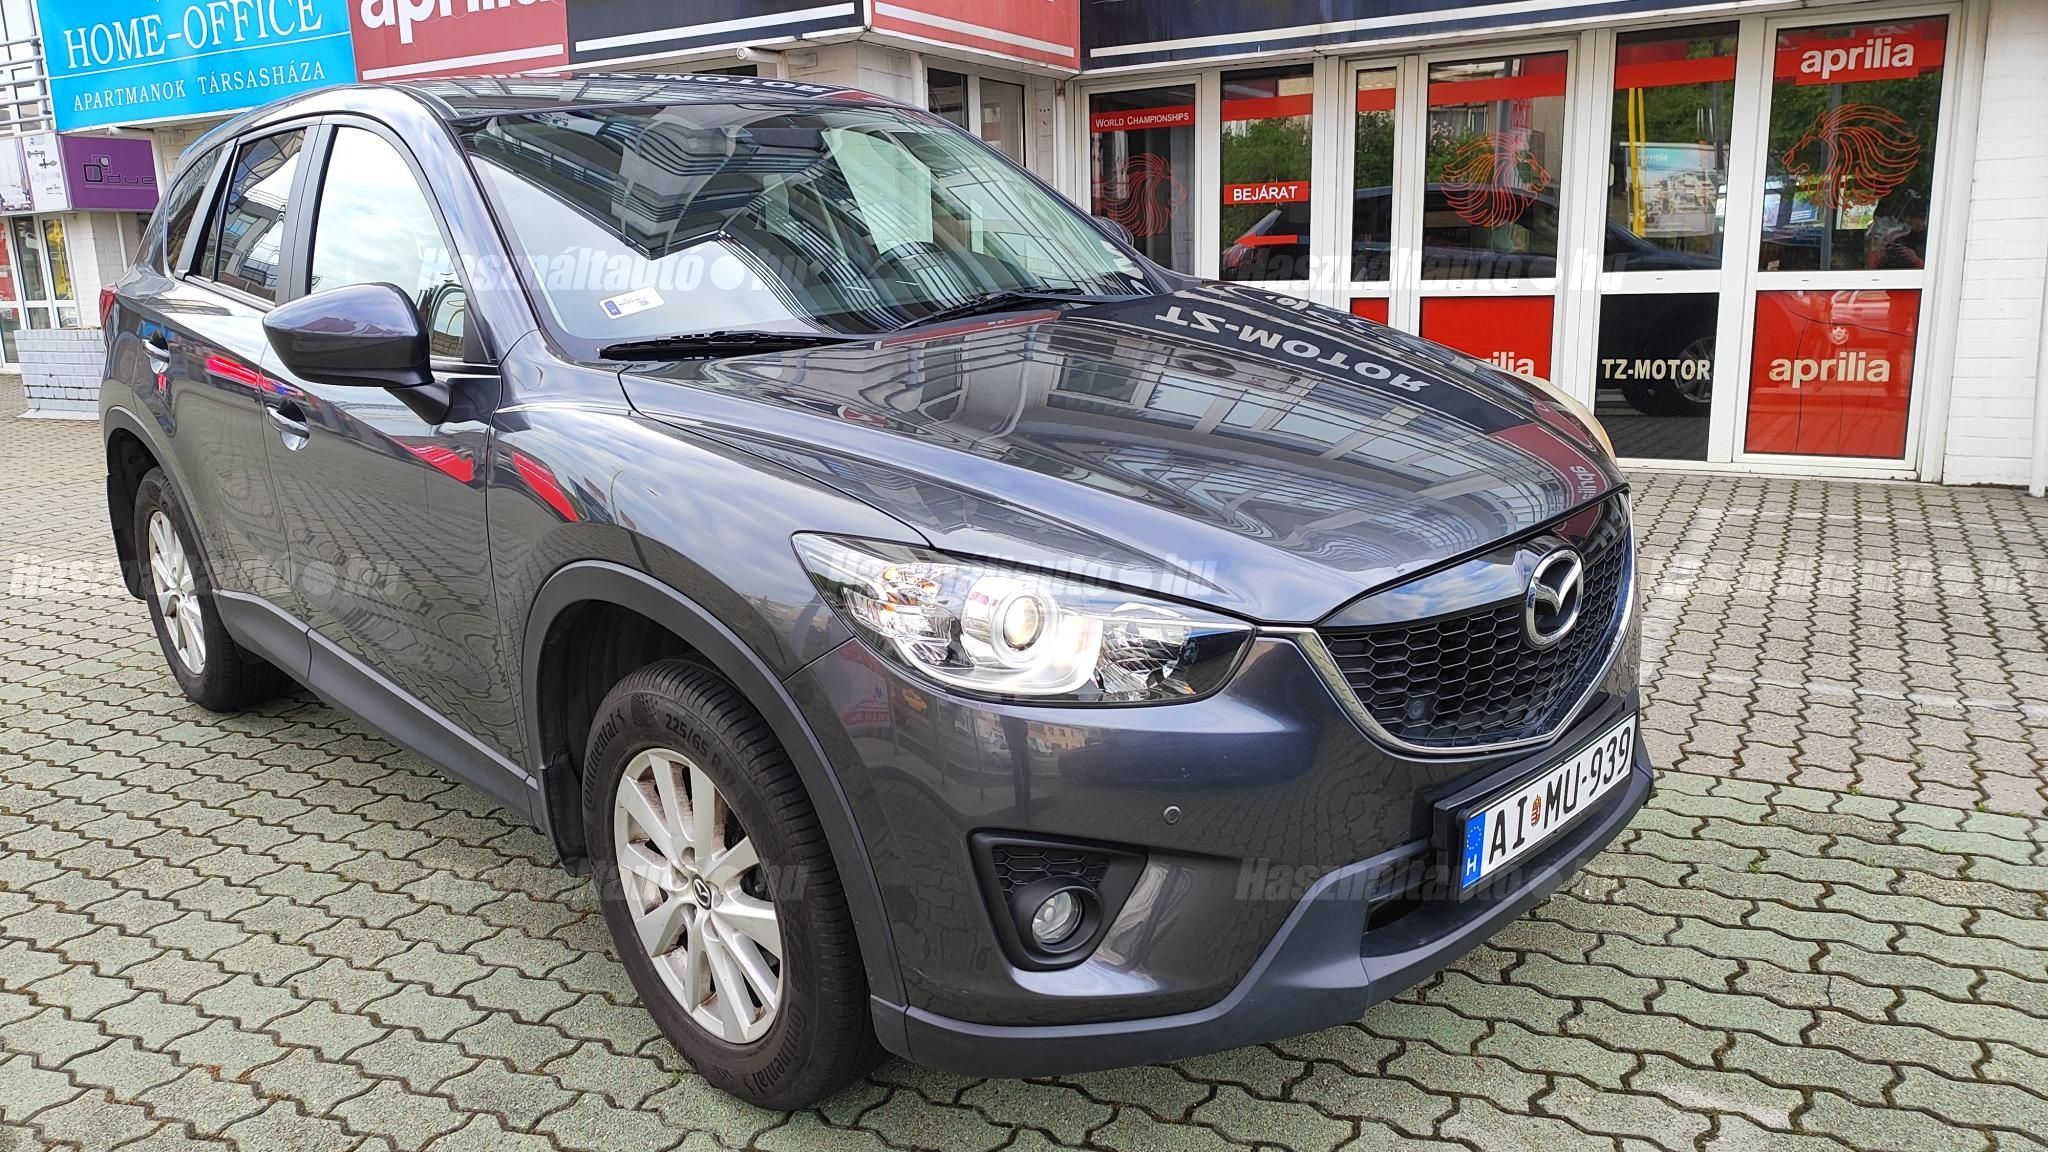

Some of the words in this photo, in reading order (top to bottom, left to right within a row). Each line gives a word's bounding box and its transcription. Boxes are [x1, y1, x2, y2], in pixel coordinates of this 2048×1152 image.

[63, 0, 323, 69] HOME-OFFICE
[1800, 37, 1914, 79] aprilia
[73, 80, 187, 112] APARTMANOK
[197, 60, 326, 96] TÁRSASHÁZA
[1095, 118, 1124, 128] WORLD
[1233, 183, 1298, 201] BEJÁRAT
[1601, 358, 1711, 380] TZ-MOTOR
[1768, 351, 1891, 389] aprilia
[665, 713, 708, 757] 225/65
[1488, 796, 1527, 865] AI
[1543, 726, 1631, 829] MU-939
[1466, 854, 1478, 877] H
